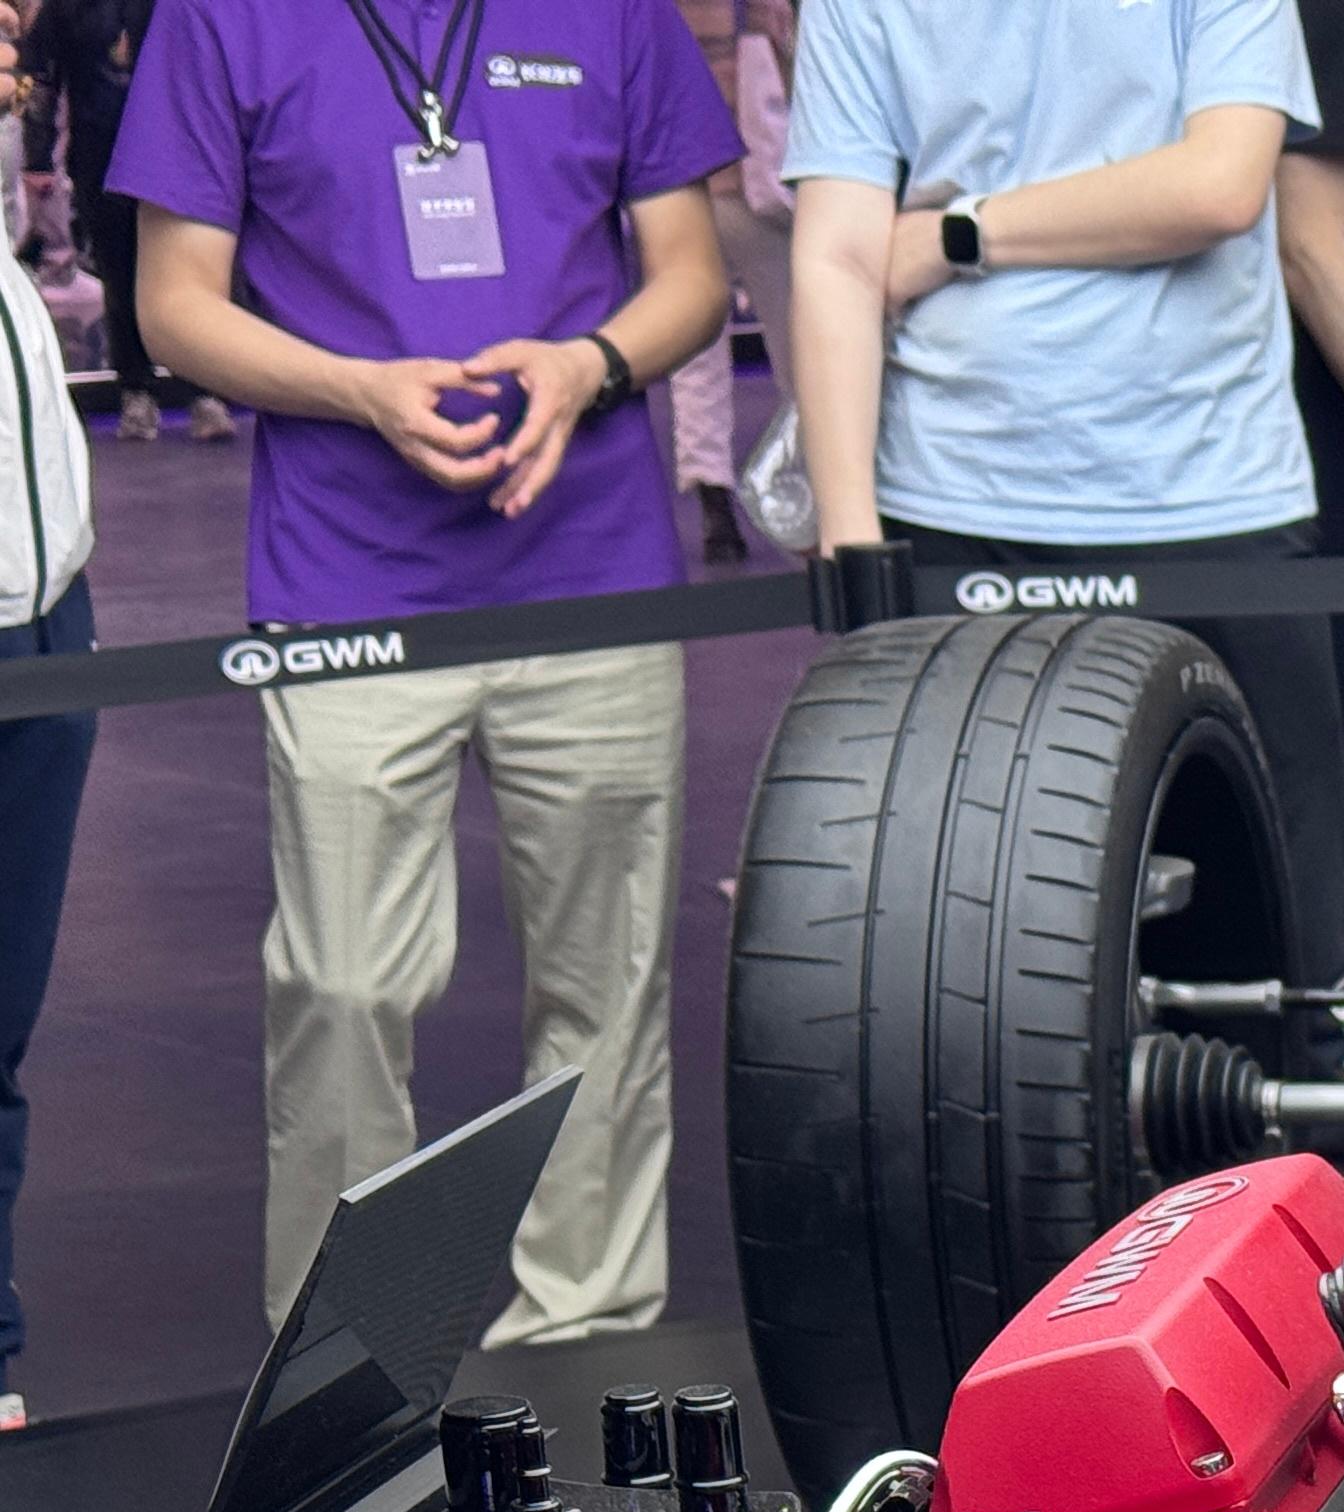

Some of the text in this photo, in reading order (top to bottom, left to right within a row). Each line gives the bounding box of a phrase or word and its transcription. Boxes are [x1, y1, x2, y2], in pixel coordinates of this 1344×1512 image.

[1016, 574, 1138, 608] GWM
[283, 631, 405, 674] GWM
[1047, 1213, 1194, 1321] GWM
